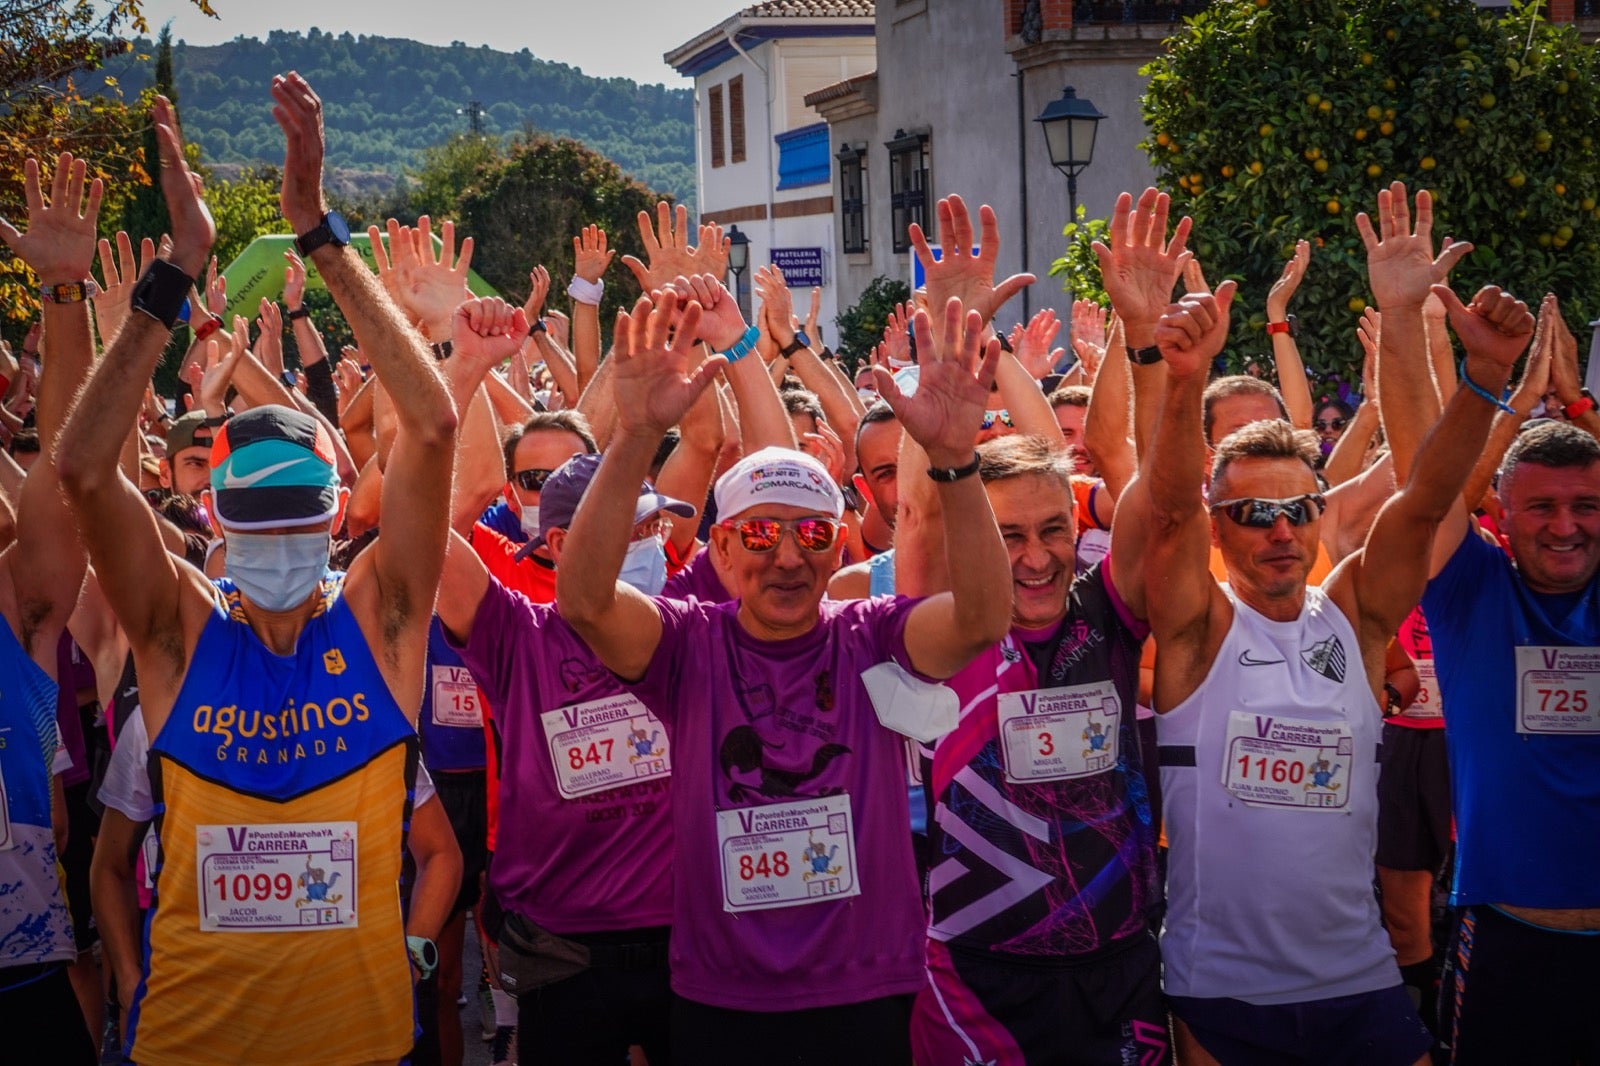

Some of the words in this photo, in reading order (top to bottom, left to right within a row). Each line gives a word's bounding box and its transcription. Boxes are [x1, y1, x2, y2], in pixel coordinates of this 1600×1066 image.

[226, 267, 267, 312] Deportes
[1541, 649, 1558, 669] V
[449, 668, 460, 682] V
[451, 694, 475, 711] 15
[1020, 693, 1037, 715] V
[1038, 699, 1089, 714] CARRERA
[1537, 689, 1588, 713] 725
[193, 692, 370, 747] agustinos
[562, 707, 578, 728] V
[581, 708, 630, 725] CARRERA
[1255, 716, 1273, 738] V
[1038, 732, 1054, 756] 3
[1271, 731, 1322, 744] CARRERA
[216, 736, 347, 764] GRANADA
[568, 738, 614, 770] 847
[1237, 754, 1305, 784] 1160
[737, 810, 753, 833] V
[755, 817, 809, 832] CARRERA
[227, 827, 247, 851] V
[248, 840, 308, 851] CARRERA
[739, 851, 789, 880] 848
[213, 873, 292, 902] 1099
[230, 907, 258, 916] JACOB
